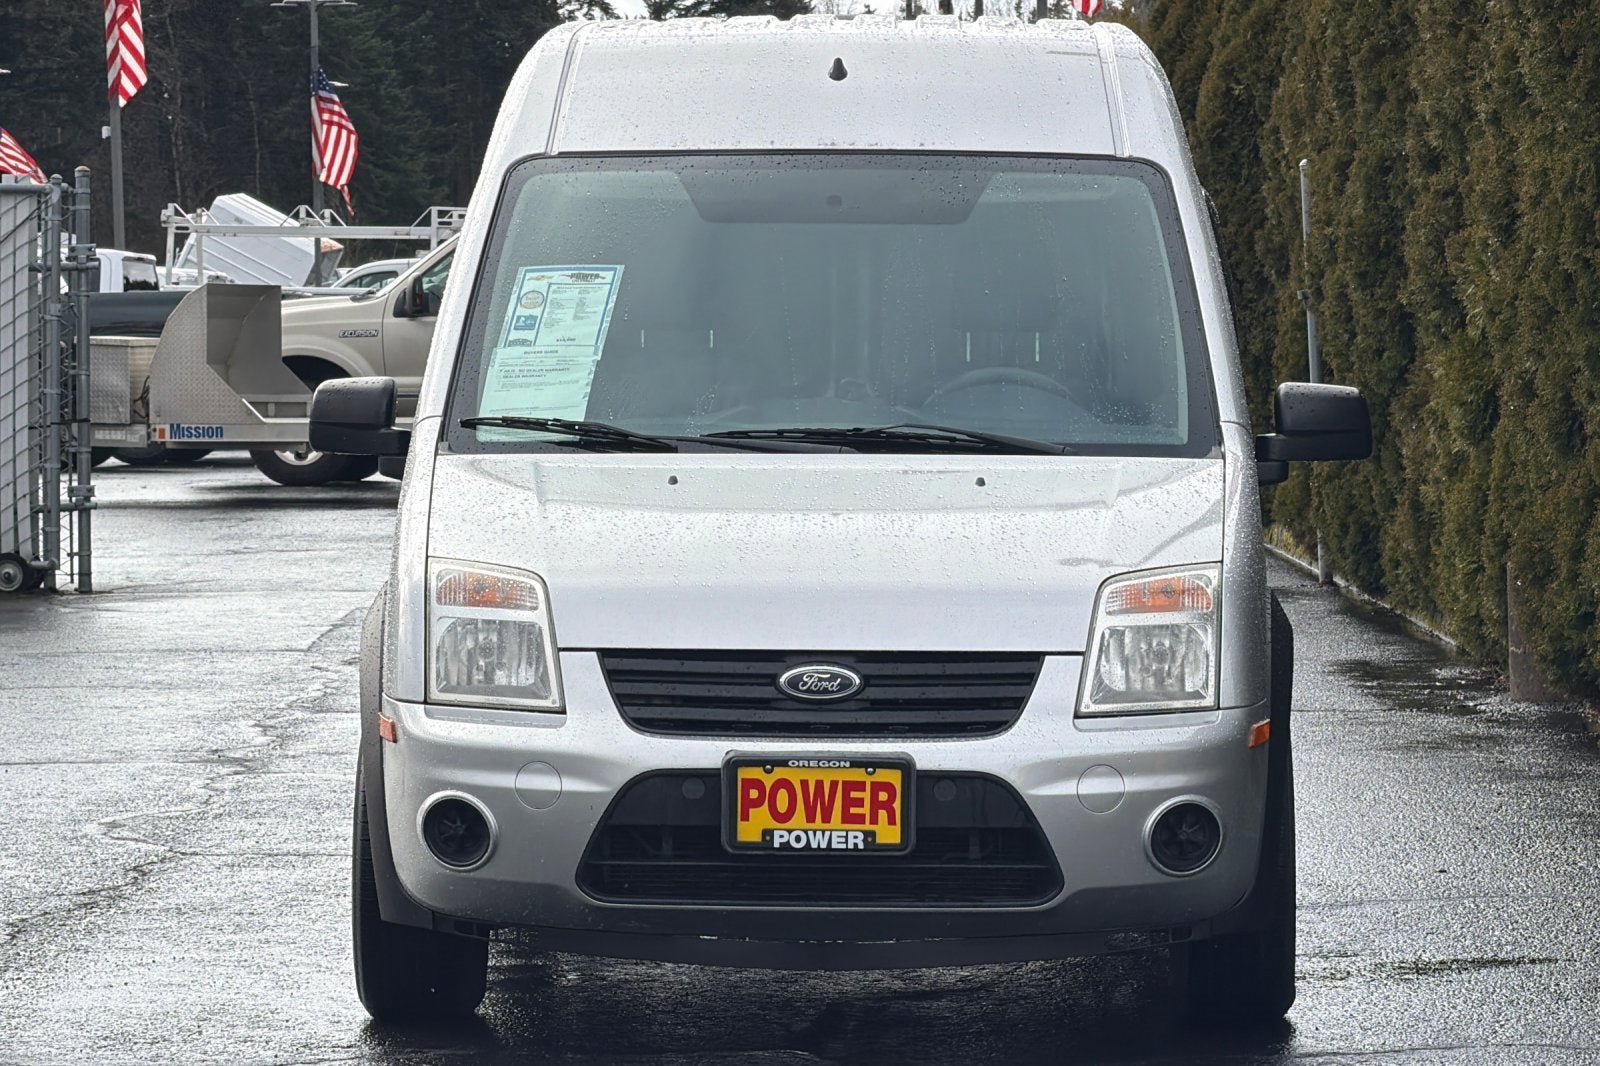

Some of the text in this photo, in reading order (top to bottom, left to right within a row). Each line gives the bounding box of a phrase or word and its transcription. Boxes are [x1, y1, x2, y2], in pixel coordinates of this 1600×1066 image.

[338, 329, 379, 338] EXCURSION
[798, 672, 842, 692] Ford
[788, 760, 851, 768] OREGON
[739, 777, 898, 826] POWER
[773, 830, 865, 850] POWER
